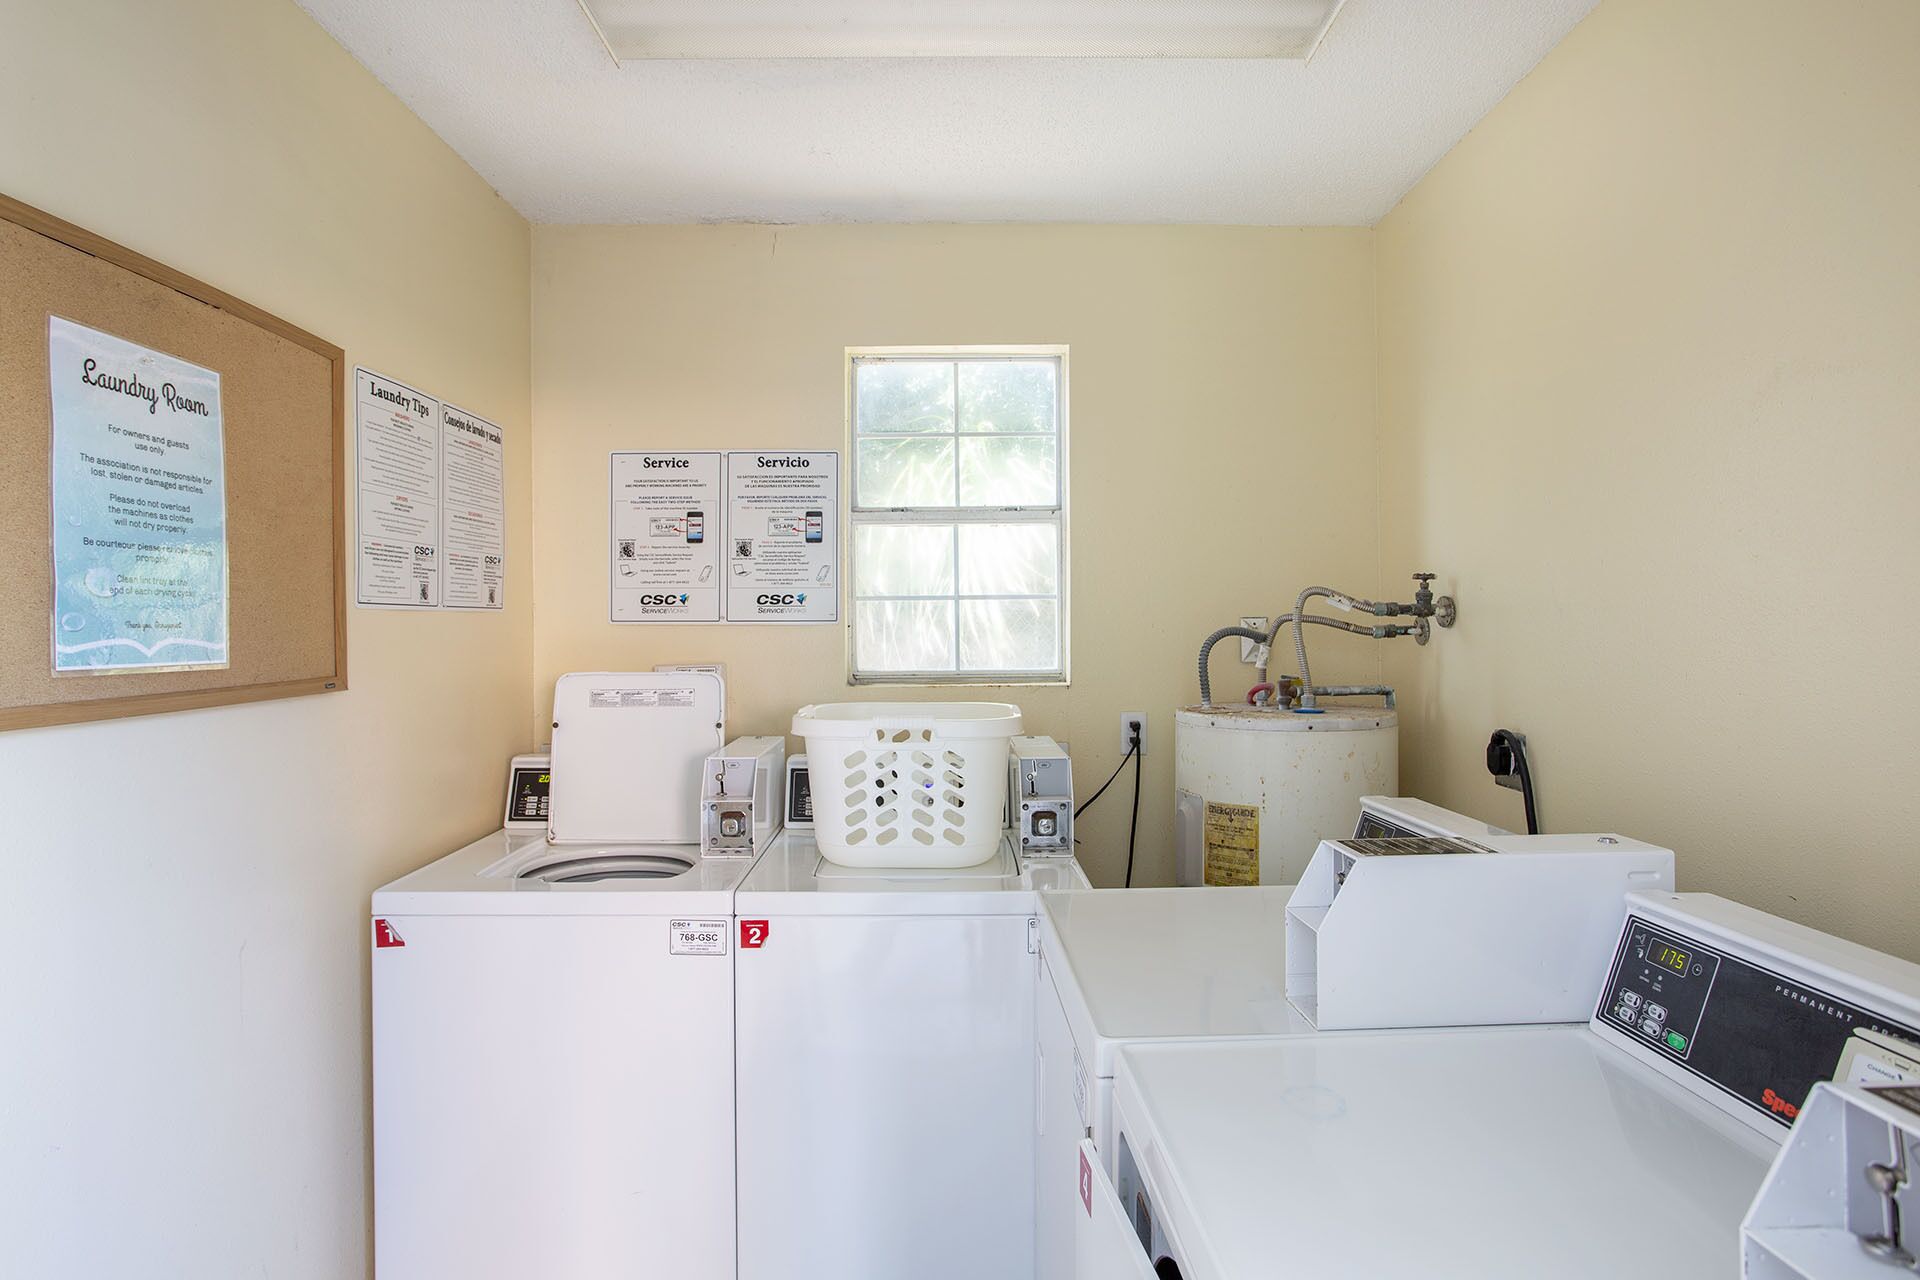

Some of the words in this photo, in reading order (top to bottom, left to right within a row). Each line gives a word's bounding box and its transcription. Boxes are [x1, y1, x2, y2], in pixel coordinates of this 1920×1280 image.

[82, 359, 159, 414] Laundry
[162, 383, 208, 416] Room
[370, 382, 410, 412] Laundry
[412, 398, 429, 418] Tips
[445, 412, 465, 432] Consejos
[466, 420, 471, 432] de
[108, 424, 121, 433] For
[123, 429, 150, 441] owners
[152, 435, 165, 444] and
[167, 439, 189, 450] guests
[80, 452, 94, 463] The
[97, 457, 140, 471] association
[150, 468, 161, 476] not
[163, 470, 201, 484] responsible
[203, 476, 212, 485] for
[643, 457, 689, 468] Service
[758, 457, 810, 468] Servicio
[110, 470, 133, 481] stolen
[145, 477, 176, 490] damaged
[109, 493, 135, 504] Please
[136, 496, 146, 506] do
[148, 499, 159, 508] not
[161, 502, 191, 512] overload
[123, 508, 158, 519] machines
[169, 514, 194, 524] clothes
[129, 519, 141, 528] not
[143, 521, 155, 531] dry
[83, 537, 94, 546] Be
[414, 546, 430, 556] CSC
[484, 556, 497, 564] CSC
[640, 594, 677, 605] CSC
[757, 594, 794, 605] CSC
[385, 930, 394, 943] 1
[680, 933, 718, 942] 768-GSC
[749, 928, 761, 944] 2
[1661, 948, 1686, 970] 175
[1775, 985, 1853, 1022] PERMANENT
[1082, 1171, 1088, 1200] 4
